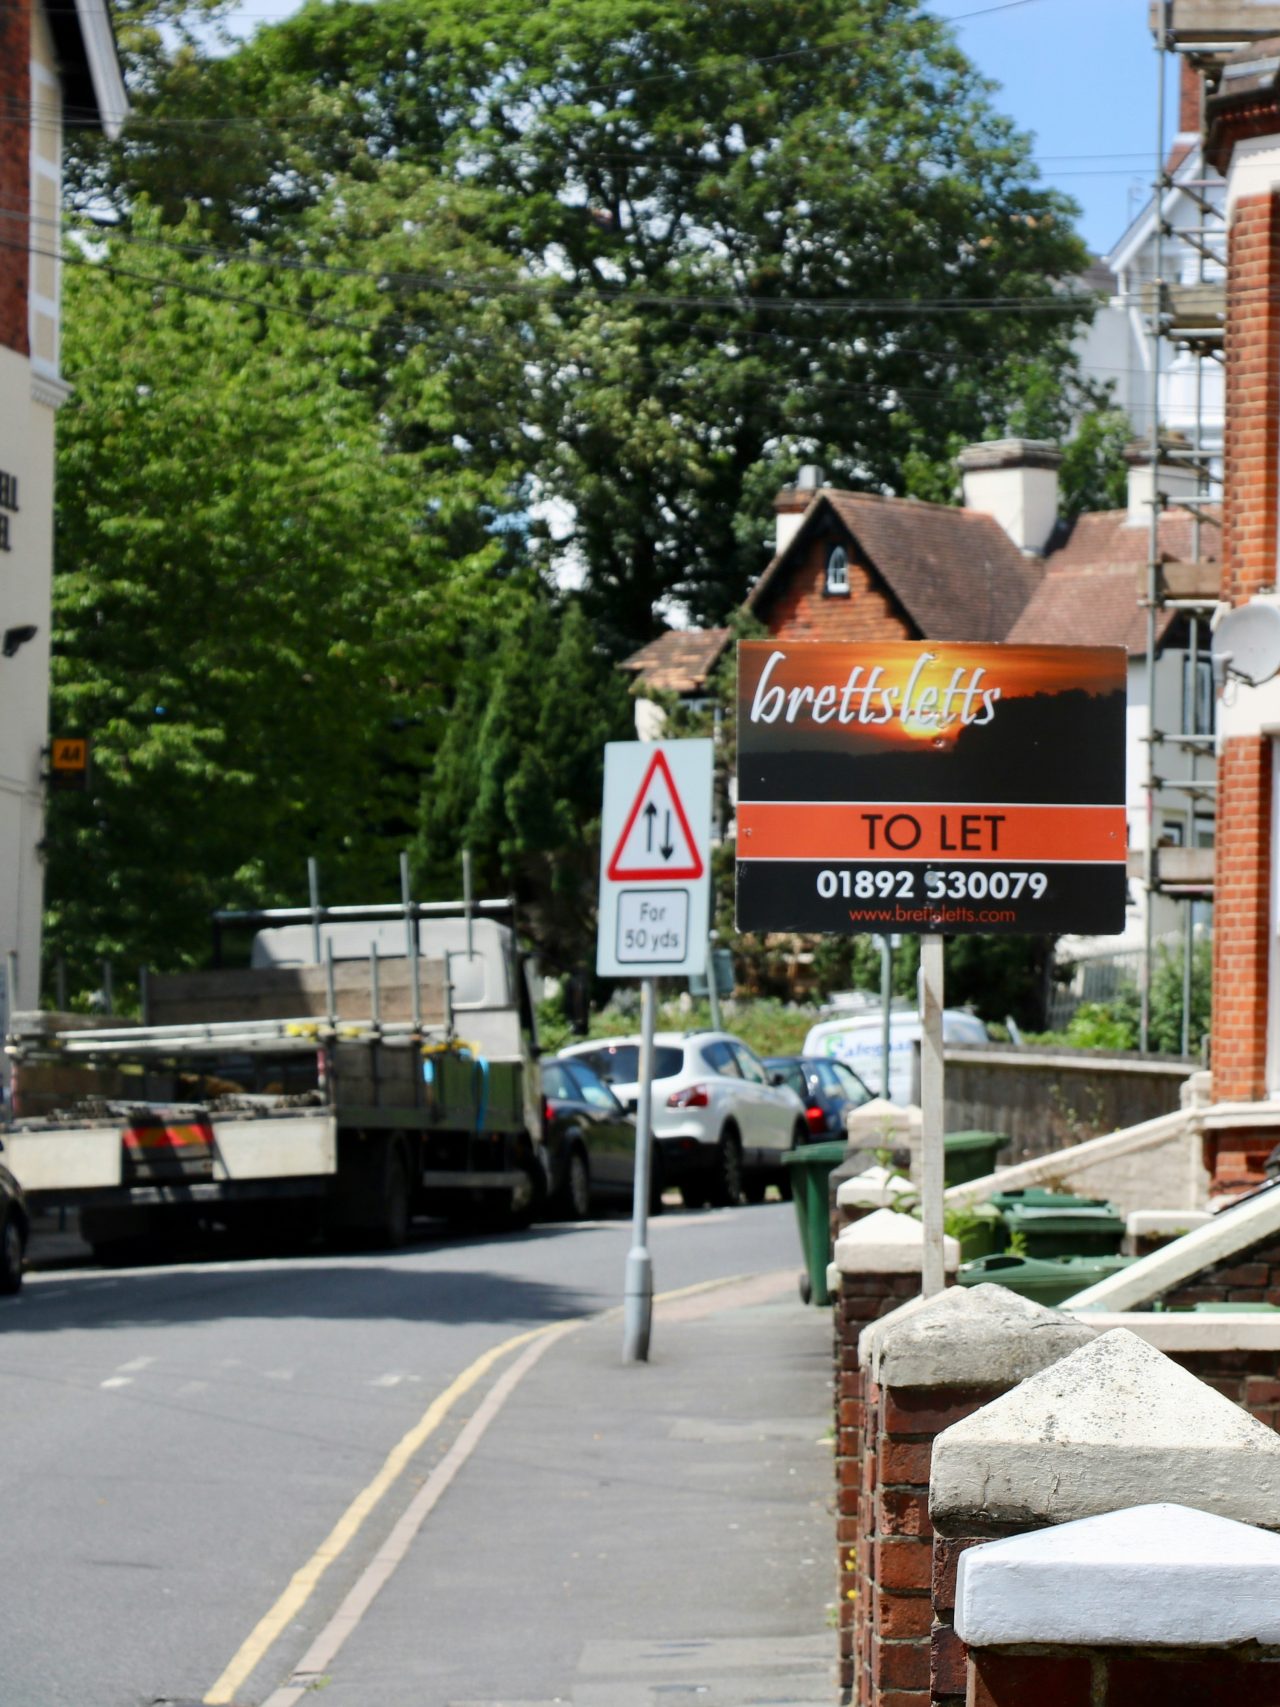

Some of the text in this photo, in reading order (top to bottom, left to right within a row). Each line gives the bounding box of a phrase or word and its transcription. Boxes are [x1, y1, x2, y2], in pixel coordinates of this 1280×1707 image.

[750, 650, 1001, 725] brettsletts
[860, 813, 1007, 851] TO LET
[816, 870, 1048, 899] 01892 530079
[640, 902, 666, 922] For
[848, 904, 1016, 924] www.brettletts.com
[624, 929, 680, 954] 50 yds
